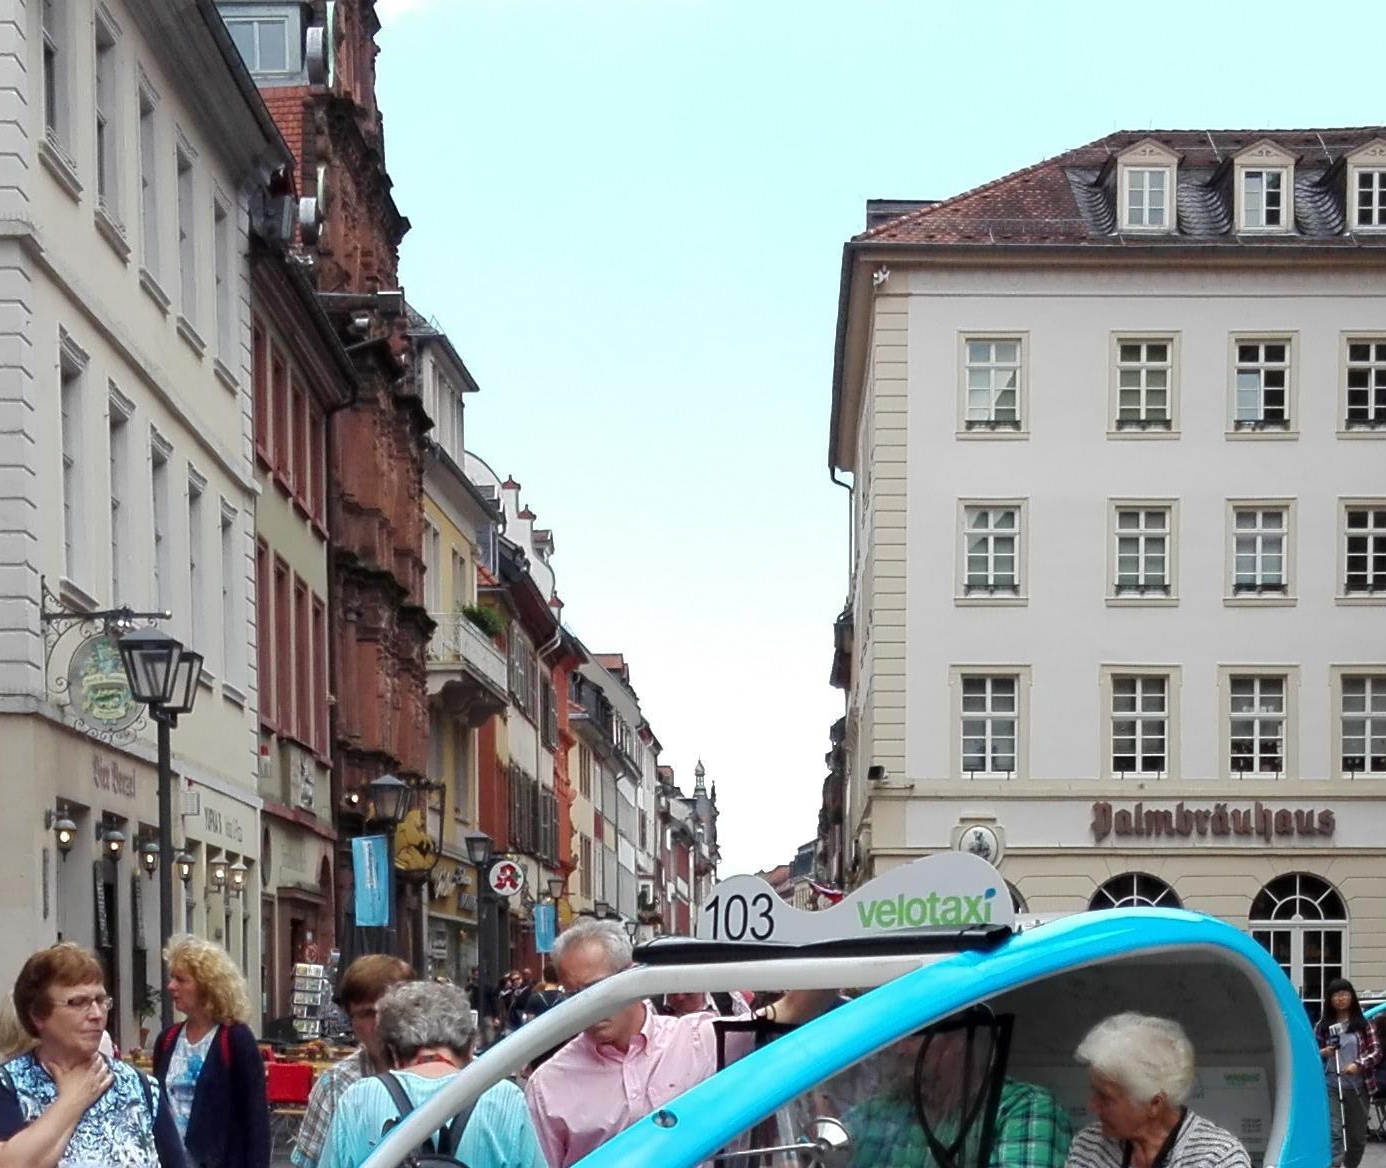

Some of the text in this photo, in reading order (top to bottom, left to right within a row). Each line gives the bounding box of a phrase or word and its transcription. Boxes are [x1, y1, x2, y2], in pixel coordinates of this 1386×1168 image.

[1090, 800, 1336, 844] Palmbräuhaus
[704, 892, 775, 942] 103
[857, 887, 997, 928] velotaxi
